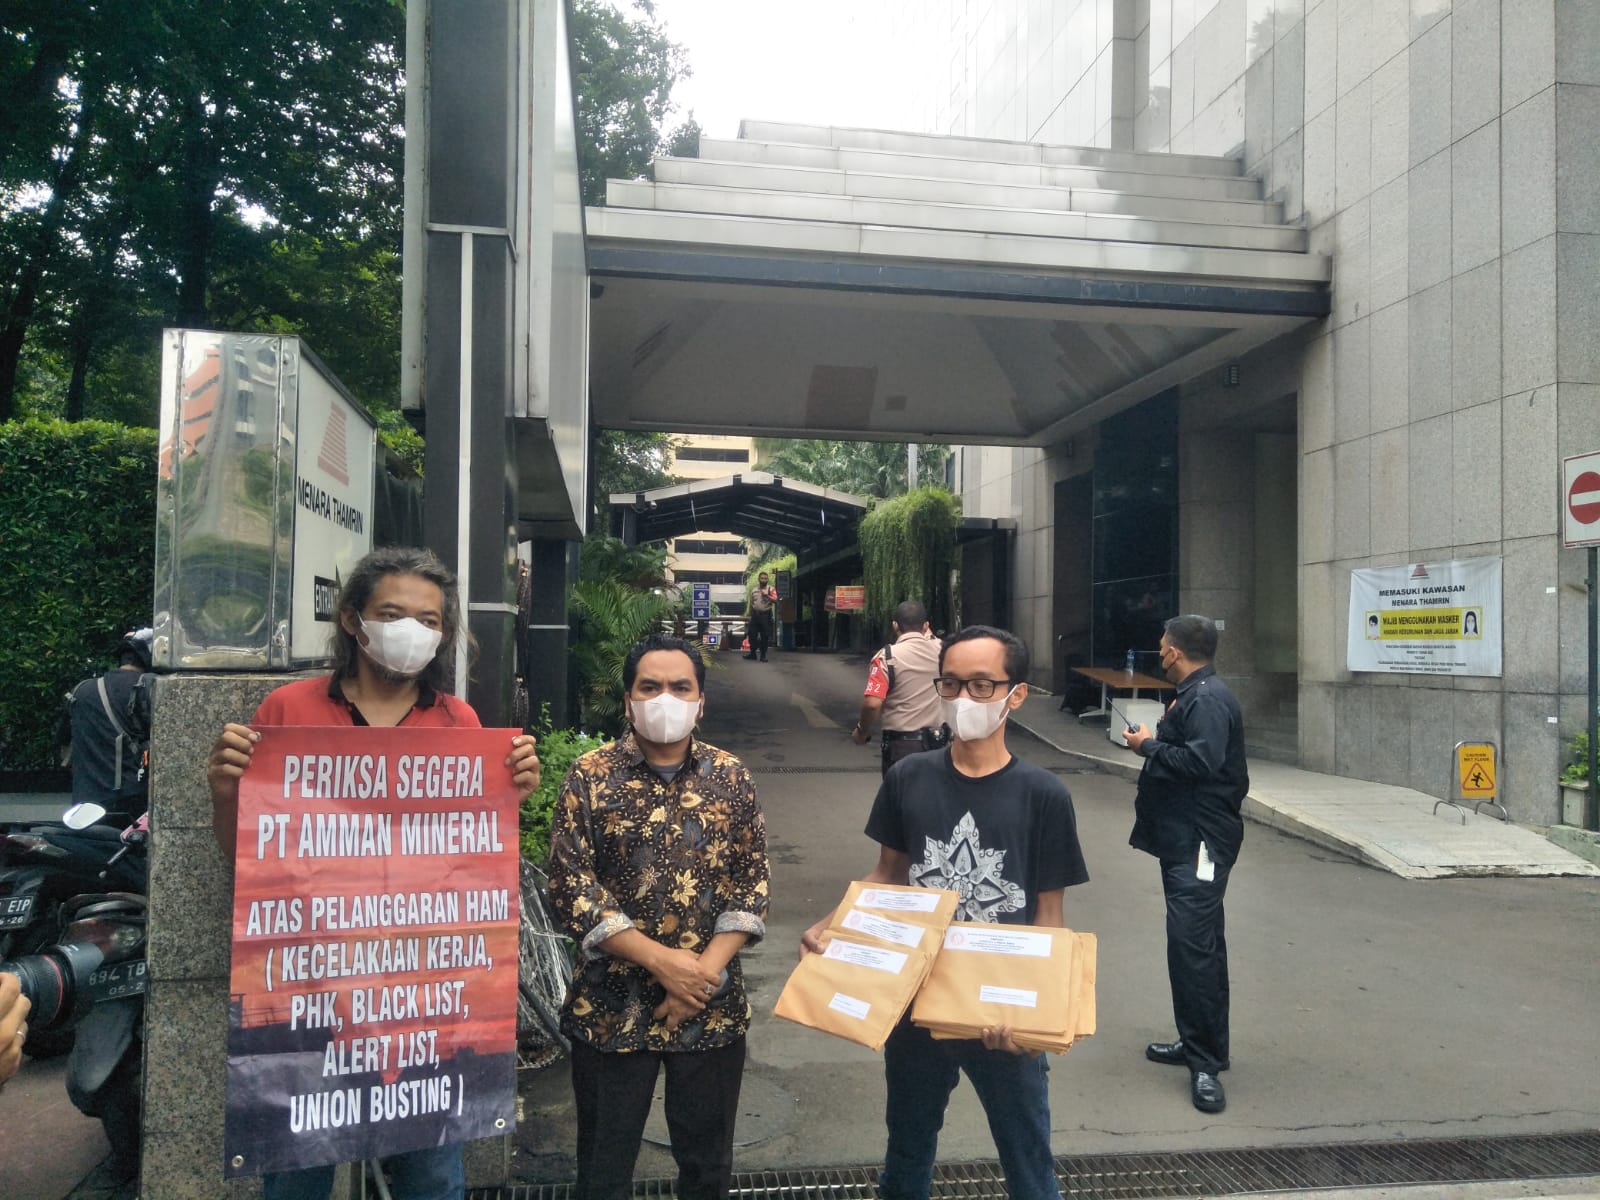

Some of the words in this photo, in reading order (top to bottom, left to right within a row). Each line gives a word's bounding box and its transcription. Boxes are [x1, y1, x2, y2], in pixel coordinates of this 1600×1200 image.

[298, 475, 331, 521] MENARA
[332, 498, 363, 536] THAMRIN
[1379, 588, 1420, 597] MEMASUKI
[1422, 585, 1465, 595] KAWASAN
[1391, 599, 1418, 607] MENARA
[1419, 597, 1450, 606] THAMRIN
[1437, 615, 1460, 625] MASKER
[284, 755, 388, 799] PERIKSA
[396, 755, 484, 799] SEGERA
[257, 813, 292, 860] PT
[297, 812, 393, 858] AMMAN
[400, 810, 504, 856] MINERAL
[8, 899, 31, 913] EIP
[246, 898, 302, 937] ATAS
[311, 891, 459, 931] PELANGGARAN
[466, 888, 509, 923] HAM
[265, 948, 275, 992] (
[281, 937, 420, 983] KECELAKAAN
[427, 934, 493, 971] KERJA,
[290, 991, 344, 1032] PHK,
[352, 984, 419, 1025] BLACK
[424, 980, 469, 1019] LIST,
[322, 1035, 392, 1077] ALERT
[397, 1029, 440, 1070] LIST,
[290, 1088, 361, 1134] UNION
[370, 1074, 451, 1123] BUSTING
[457, 1073, 464, 1117] )
